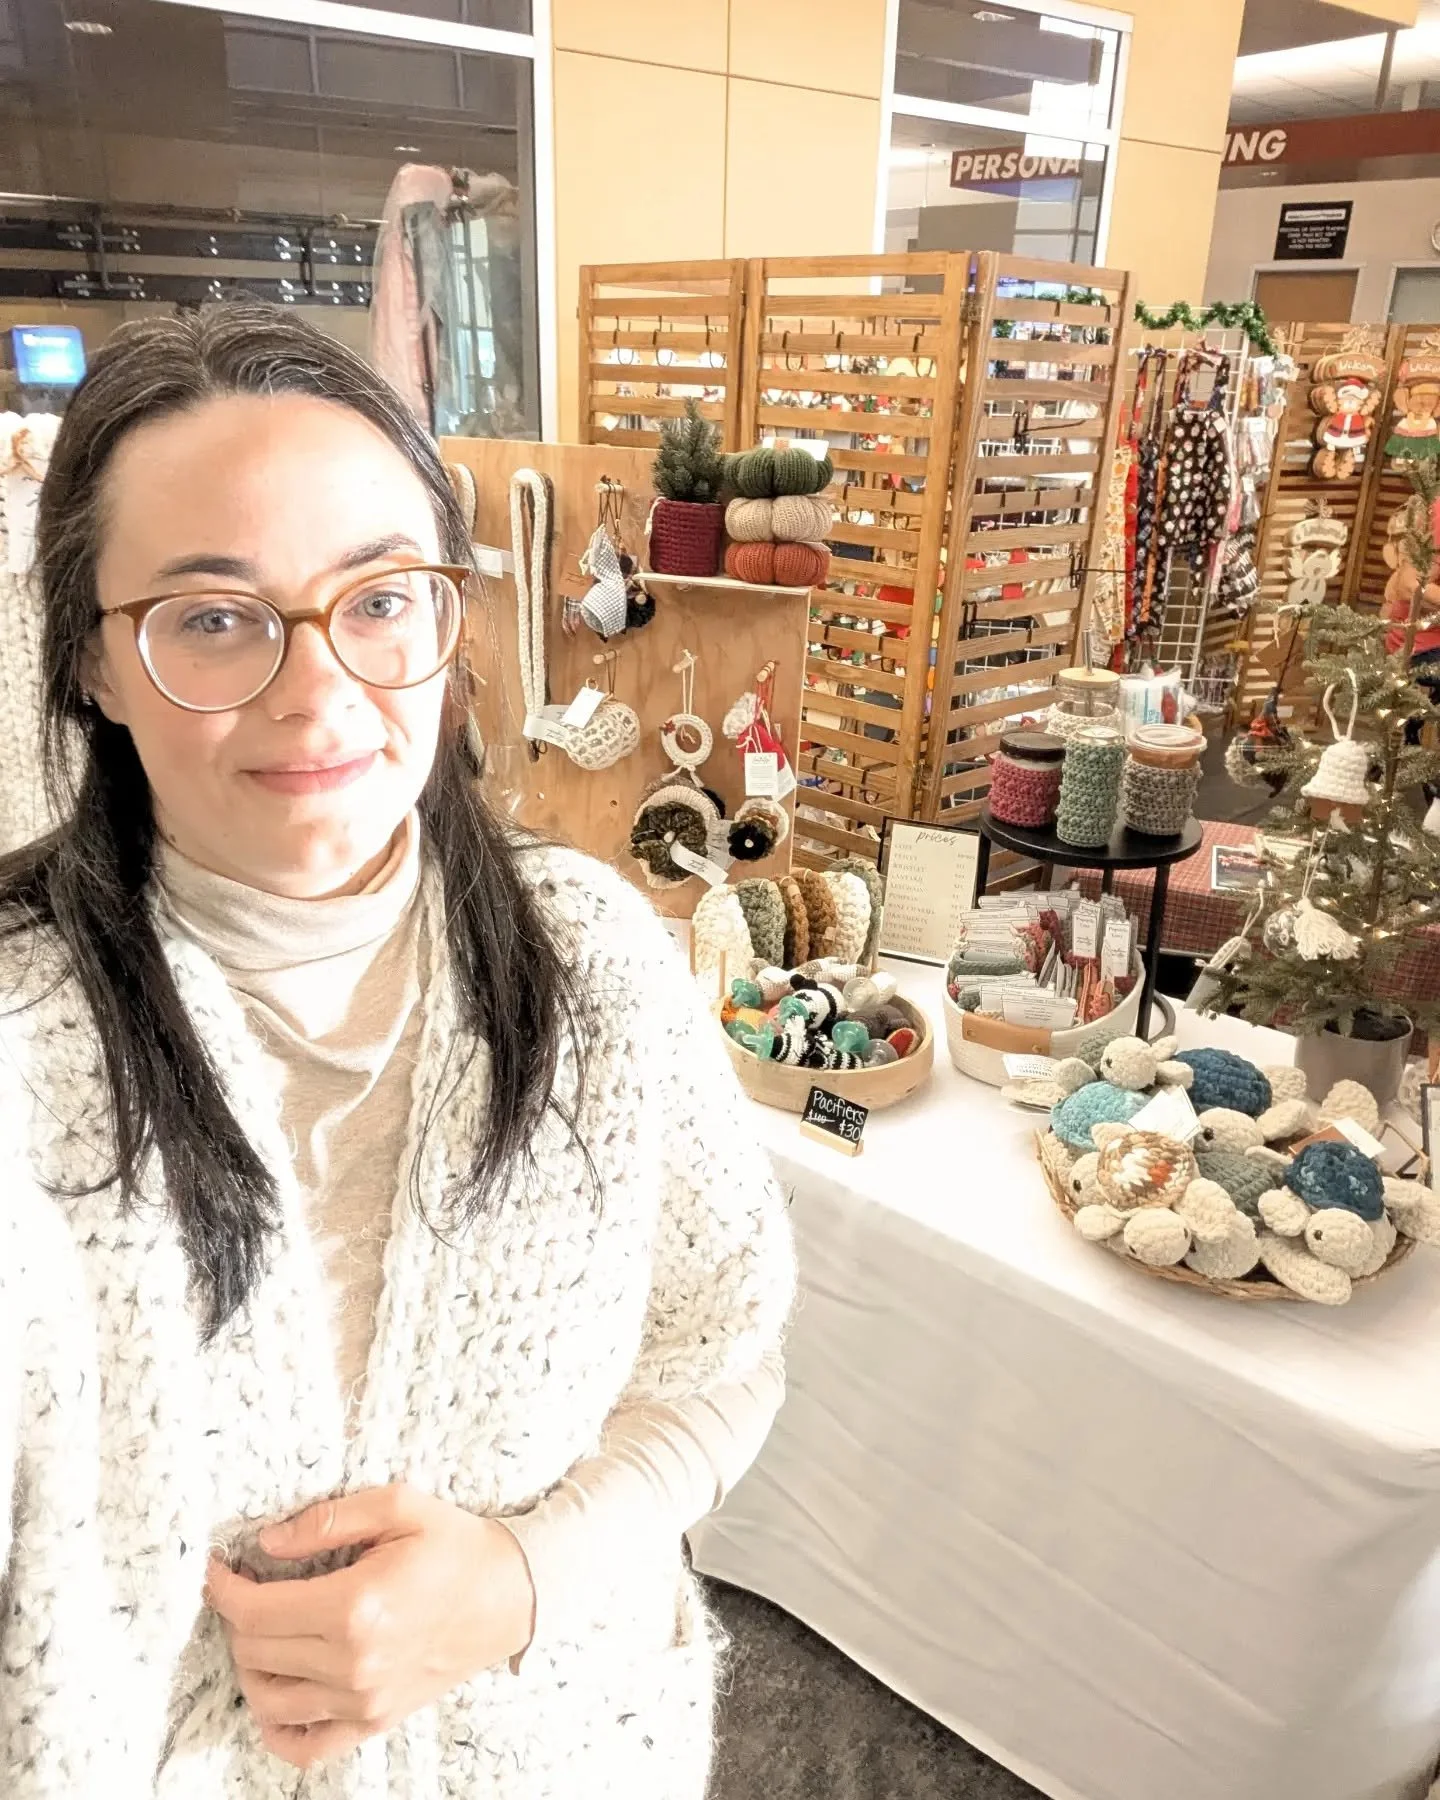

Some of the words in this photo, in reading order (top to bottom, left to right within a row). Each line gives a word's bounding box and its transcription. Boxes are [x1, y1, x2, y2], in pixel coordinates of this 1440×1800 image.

[915, 831, 959, 846] prices
[813, 1090, 865, 1126] Pacifiers
[838, 1119, 861, 1141] $30
